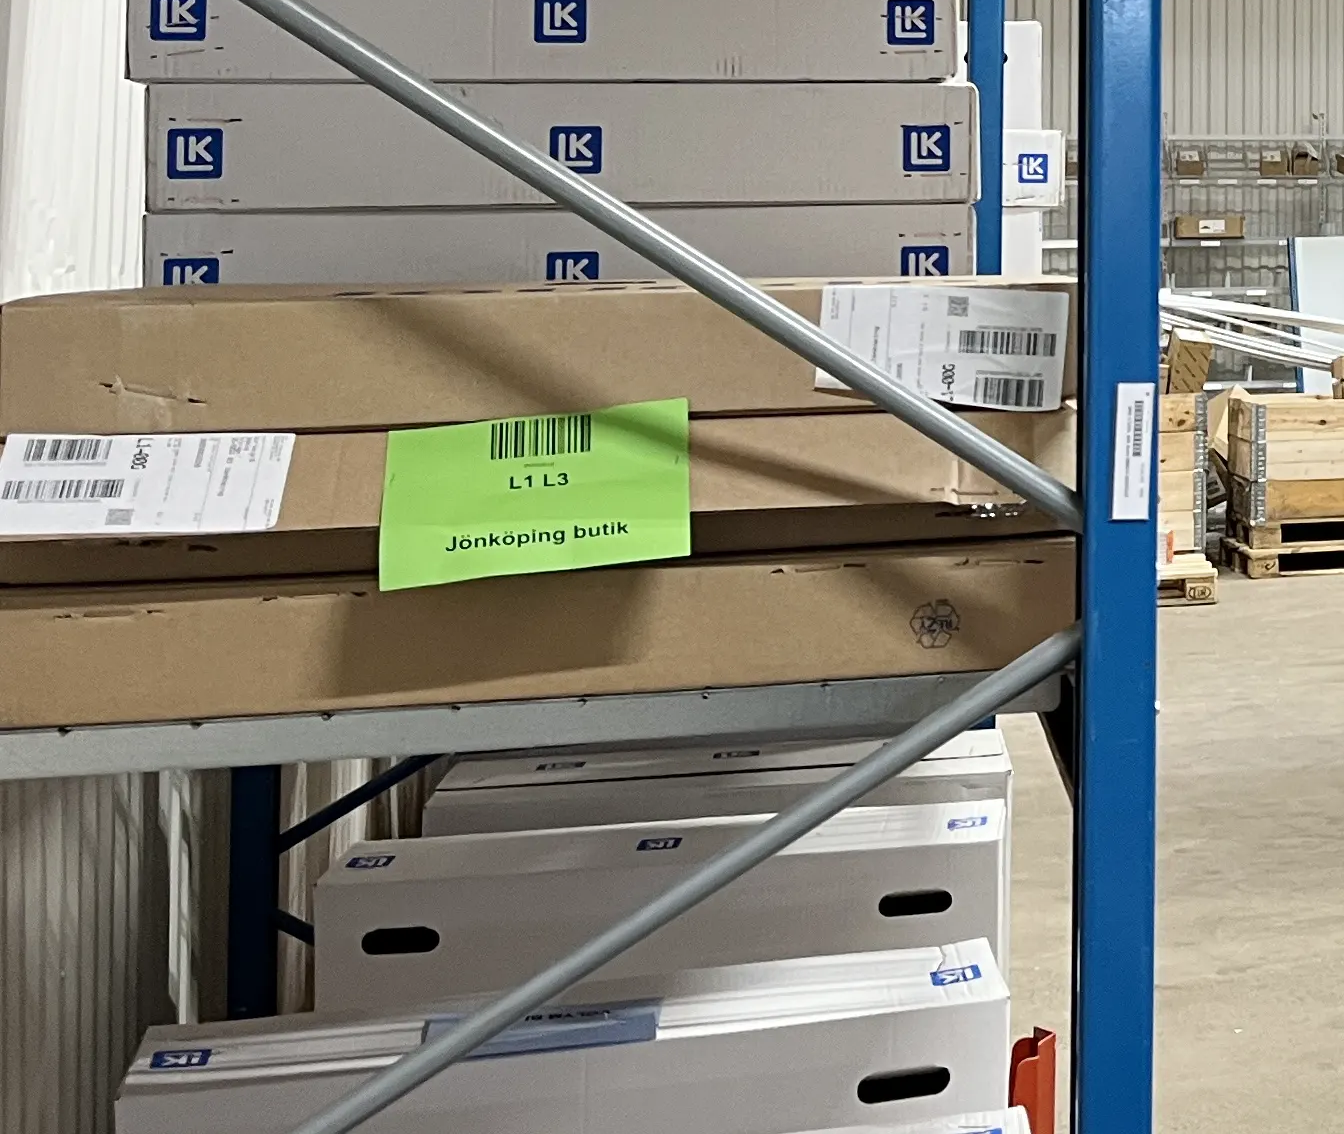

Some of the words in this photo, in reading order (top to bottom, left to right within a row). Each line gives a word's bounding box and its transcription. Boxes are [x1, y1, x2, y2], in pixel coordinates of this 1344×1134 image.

[543, 2, 578, 36] LK
[895, 5, 927, 39] LK
[176, 135, 213, 171] LK
[558, 133, 593, 167] LK
[910, 131, 943, 165] LK
[1022, 156, 1044, 179] LK
[509, 474, 534, 490] L1
[543, 472, 569, 487] L3
[445, 528, 566, 553] Jönköping
[573, 521, 629, 540] butik
